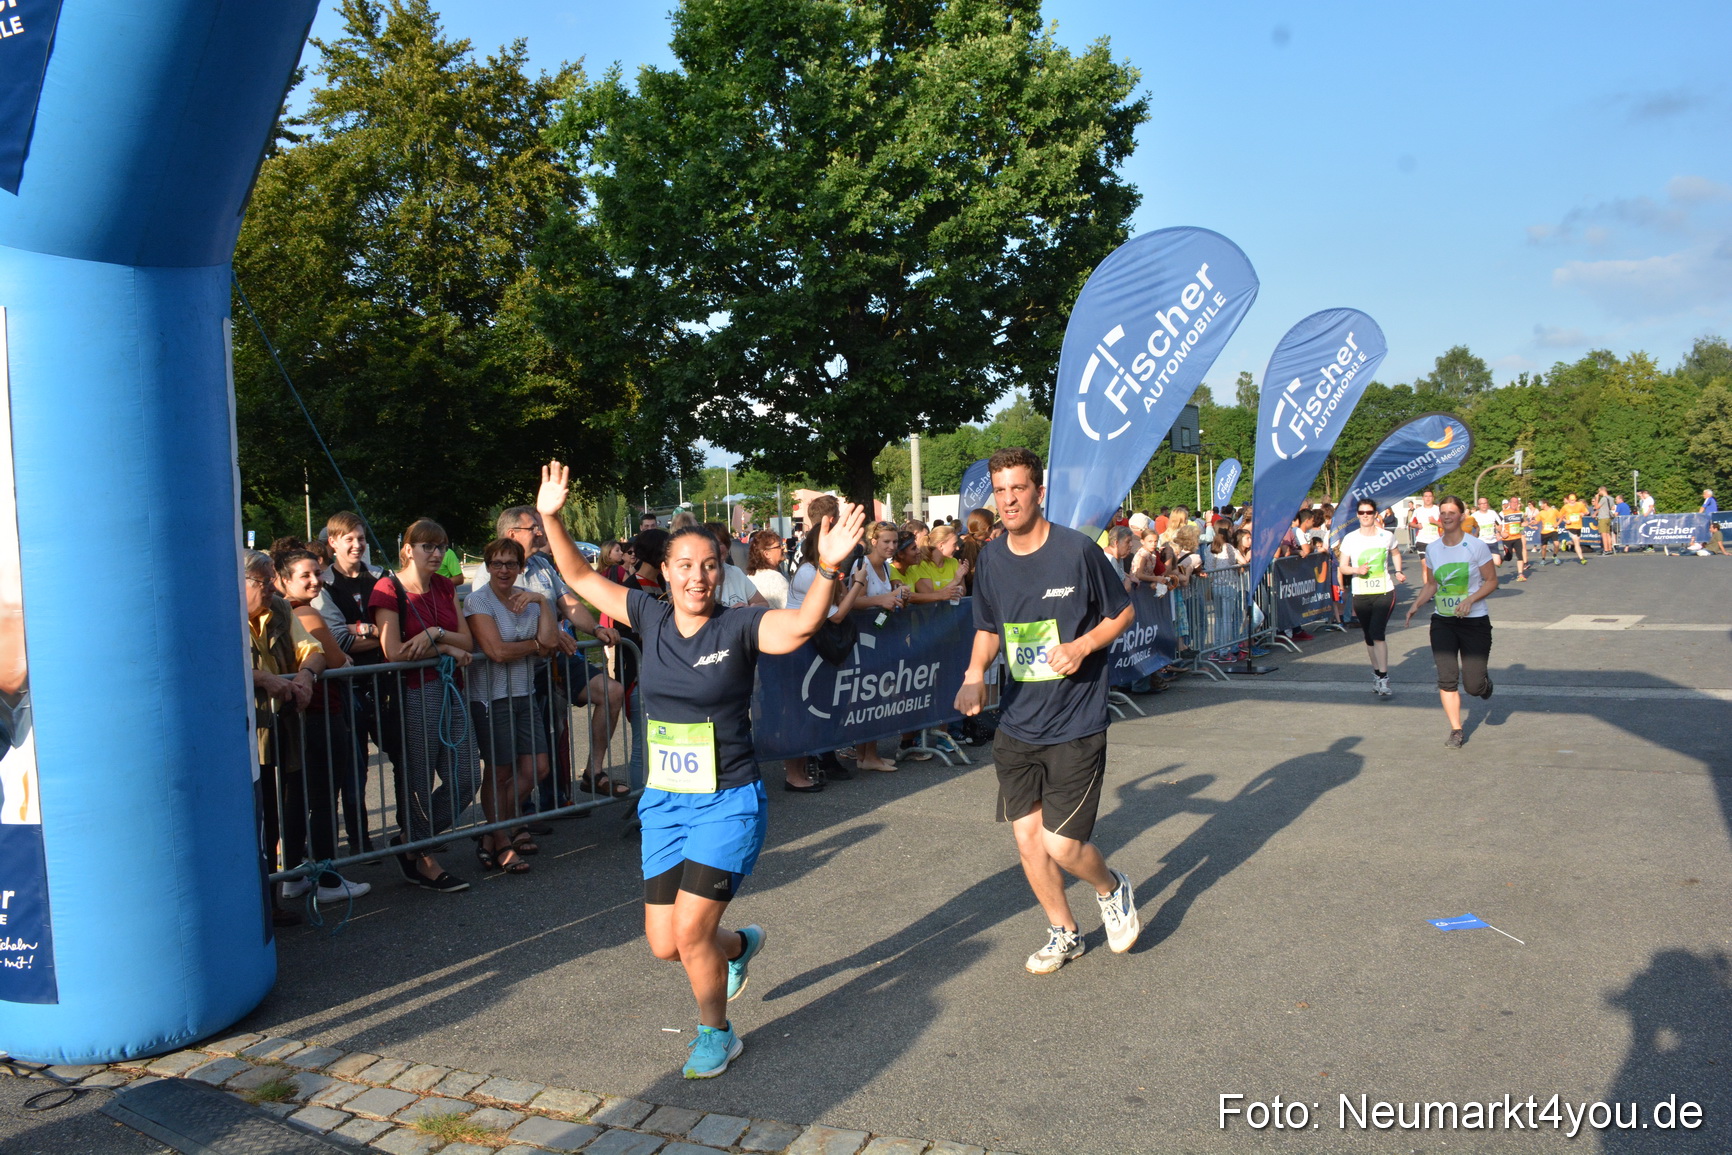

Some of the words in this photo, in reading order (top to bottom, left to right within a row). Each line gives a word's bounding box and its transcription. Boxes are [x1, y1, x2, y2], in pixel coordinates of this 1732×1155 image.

[1103, 262, 1214, 415] Fischer
[1142, 291, 1227, 414] AUTOMOBILE
[1288, 331, 1358, 441] Fischer
[1314, 350, 1367, 439] AUTOMOBILE
[1441, 443, 1466, 464] Medien
[970, 470, 991, 502] Fische
[1351, 449, 1437, 501] Frischmann
[1648, 525, 1697, 536] Fischer
[1364, 579, 1381, 588] 102
[1110, 622, 1158, 654] Ficher
[1016, 645, 1048, 666] 695
[832, 659, 940, 707] Fischer
[844, 693, 931, 727] AUTOMOBILE
[658, 749, 699, 774] 706
